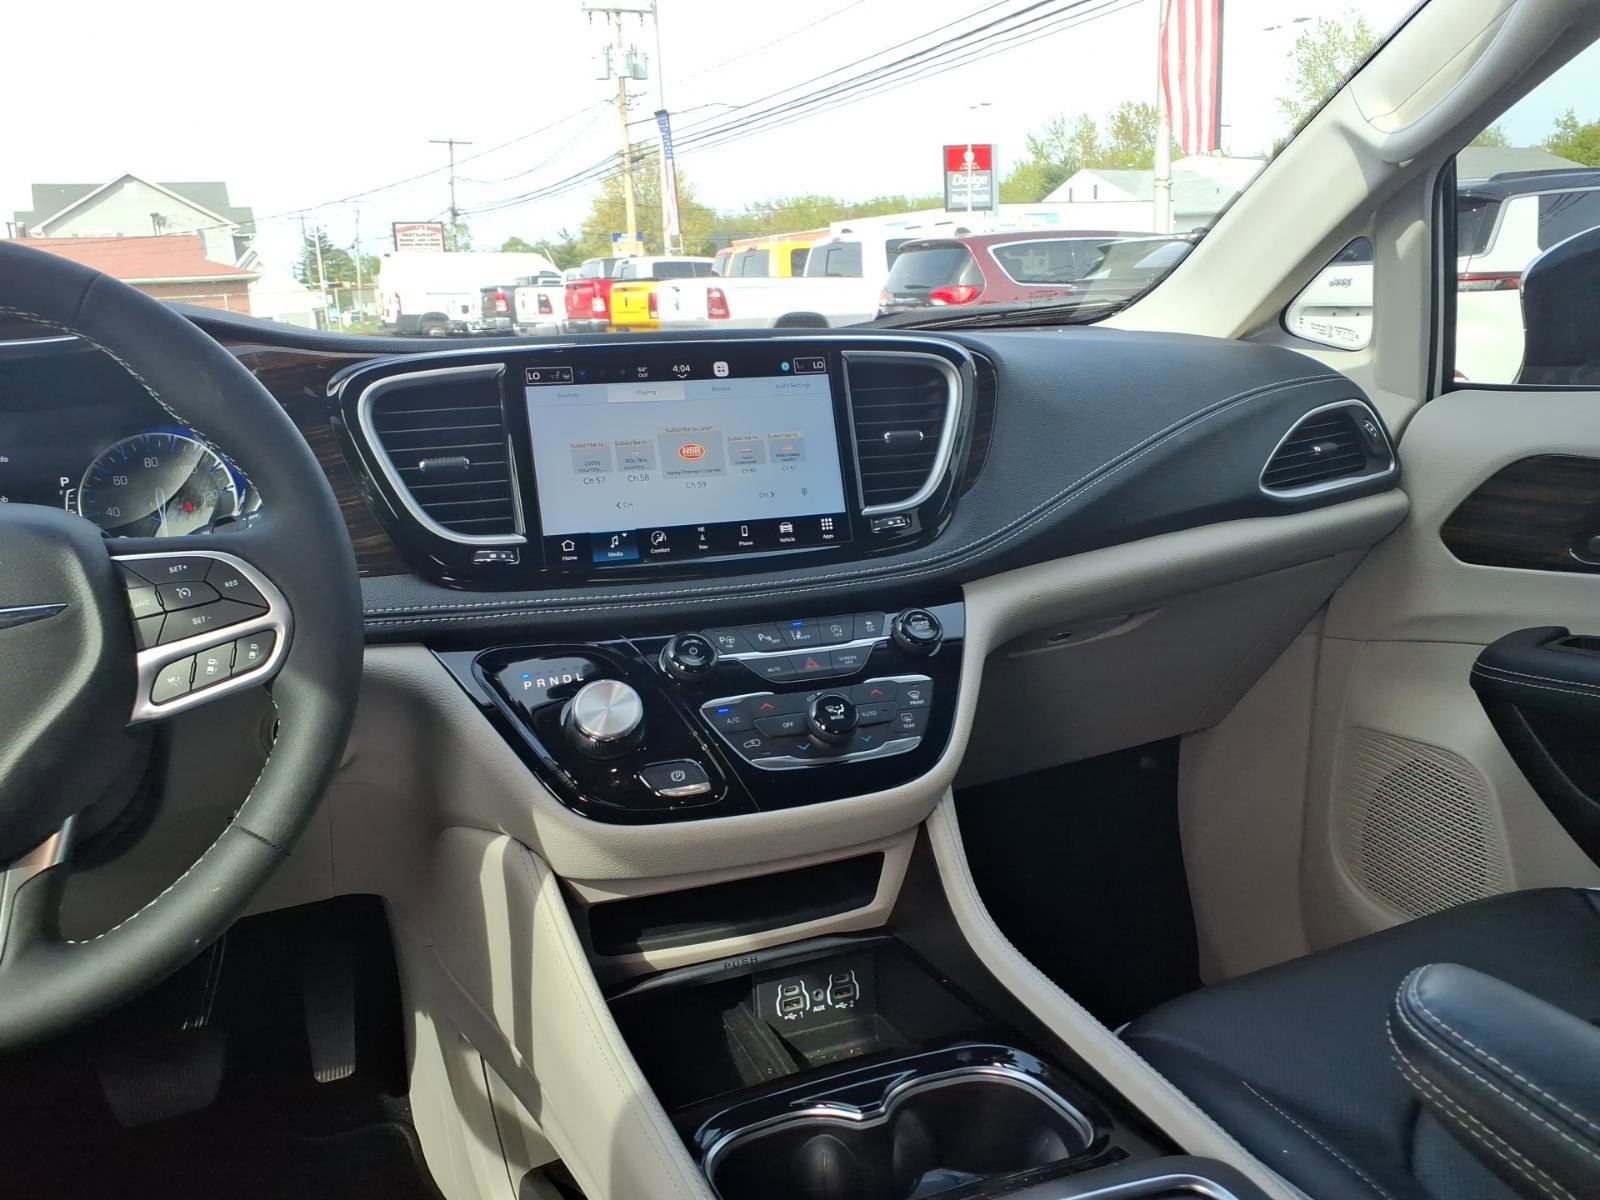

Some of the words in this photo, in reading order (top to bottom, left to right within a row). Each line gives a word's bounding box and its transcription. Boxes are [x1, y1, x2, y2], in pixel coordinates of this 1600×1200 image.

[672, 364, 691, 373] 4:04
[813, 361, 824, 369] LO
[527, 372, 541, 380] LO
[144, 457, 158, 468] 80
[60, 477, 69, 487] P
[113, 475, 128, 486] 60
[583, 477, 594, 485] Ch
[596, 476, 606, 484] 57
[685, 481, 696, 489] Ch
[697, 480, 707, 488] 59
[106, 507, 120, 517] 40
[224, 580, 239, 588] RES
[782, 721, 794, 729] OFF
[723, 956, 759, 970] PUSH
[812, 1003, 826, 1012] AUX
